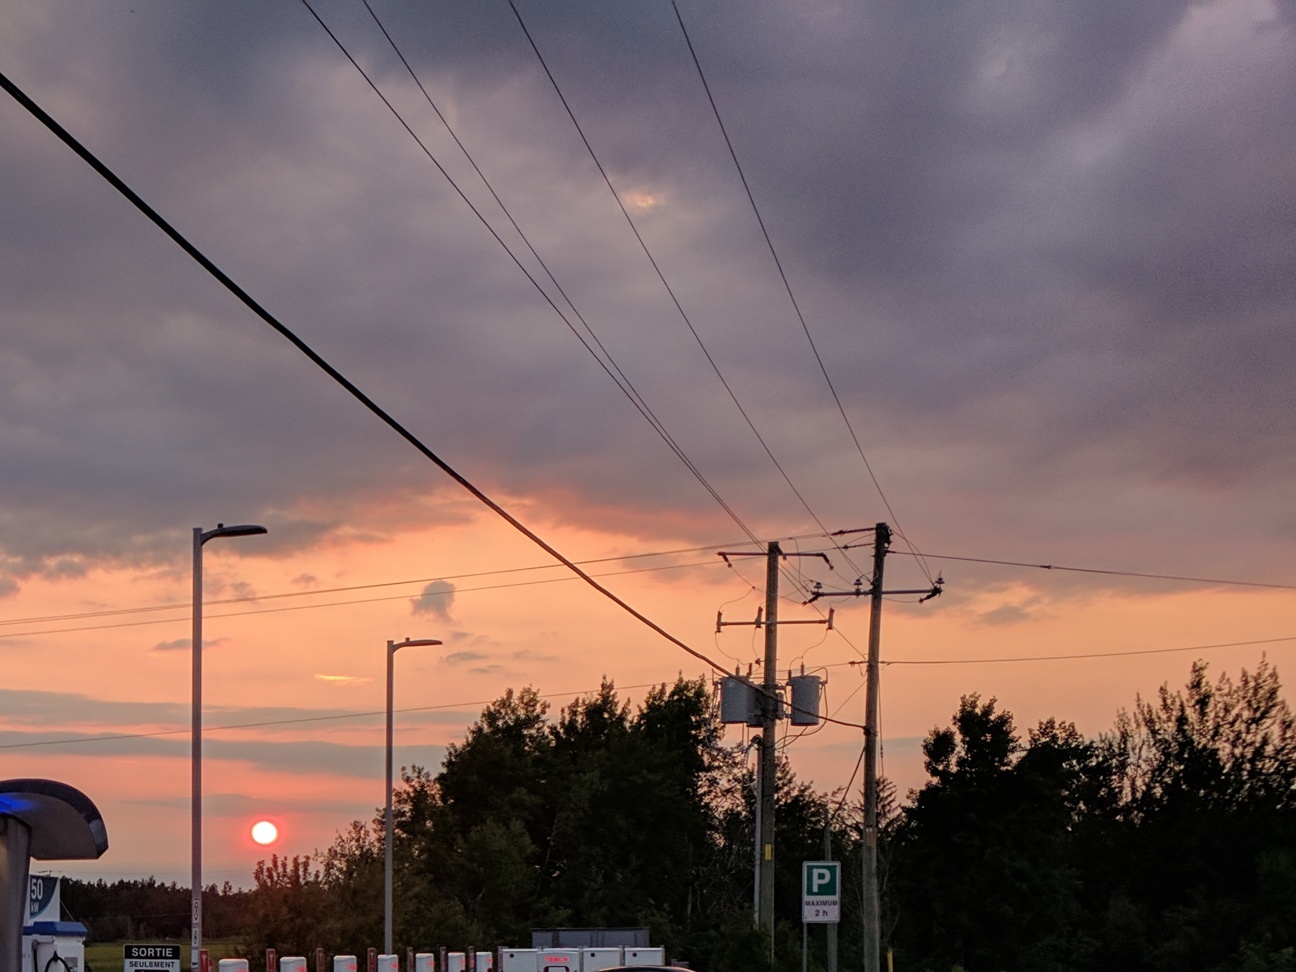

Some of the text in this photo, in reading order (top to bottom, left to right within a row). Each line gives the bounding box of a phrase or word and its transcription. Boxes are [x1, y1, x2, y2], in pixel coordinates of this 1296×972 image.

[812, 868, 831, 893] P
[31, 878, 43, 900] 50
[815, 909, 820, 917] 2
[131, 947, 173, 957] SORTIE
[129, 960, 175, 968] SEULEMENT
